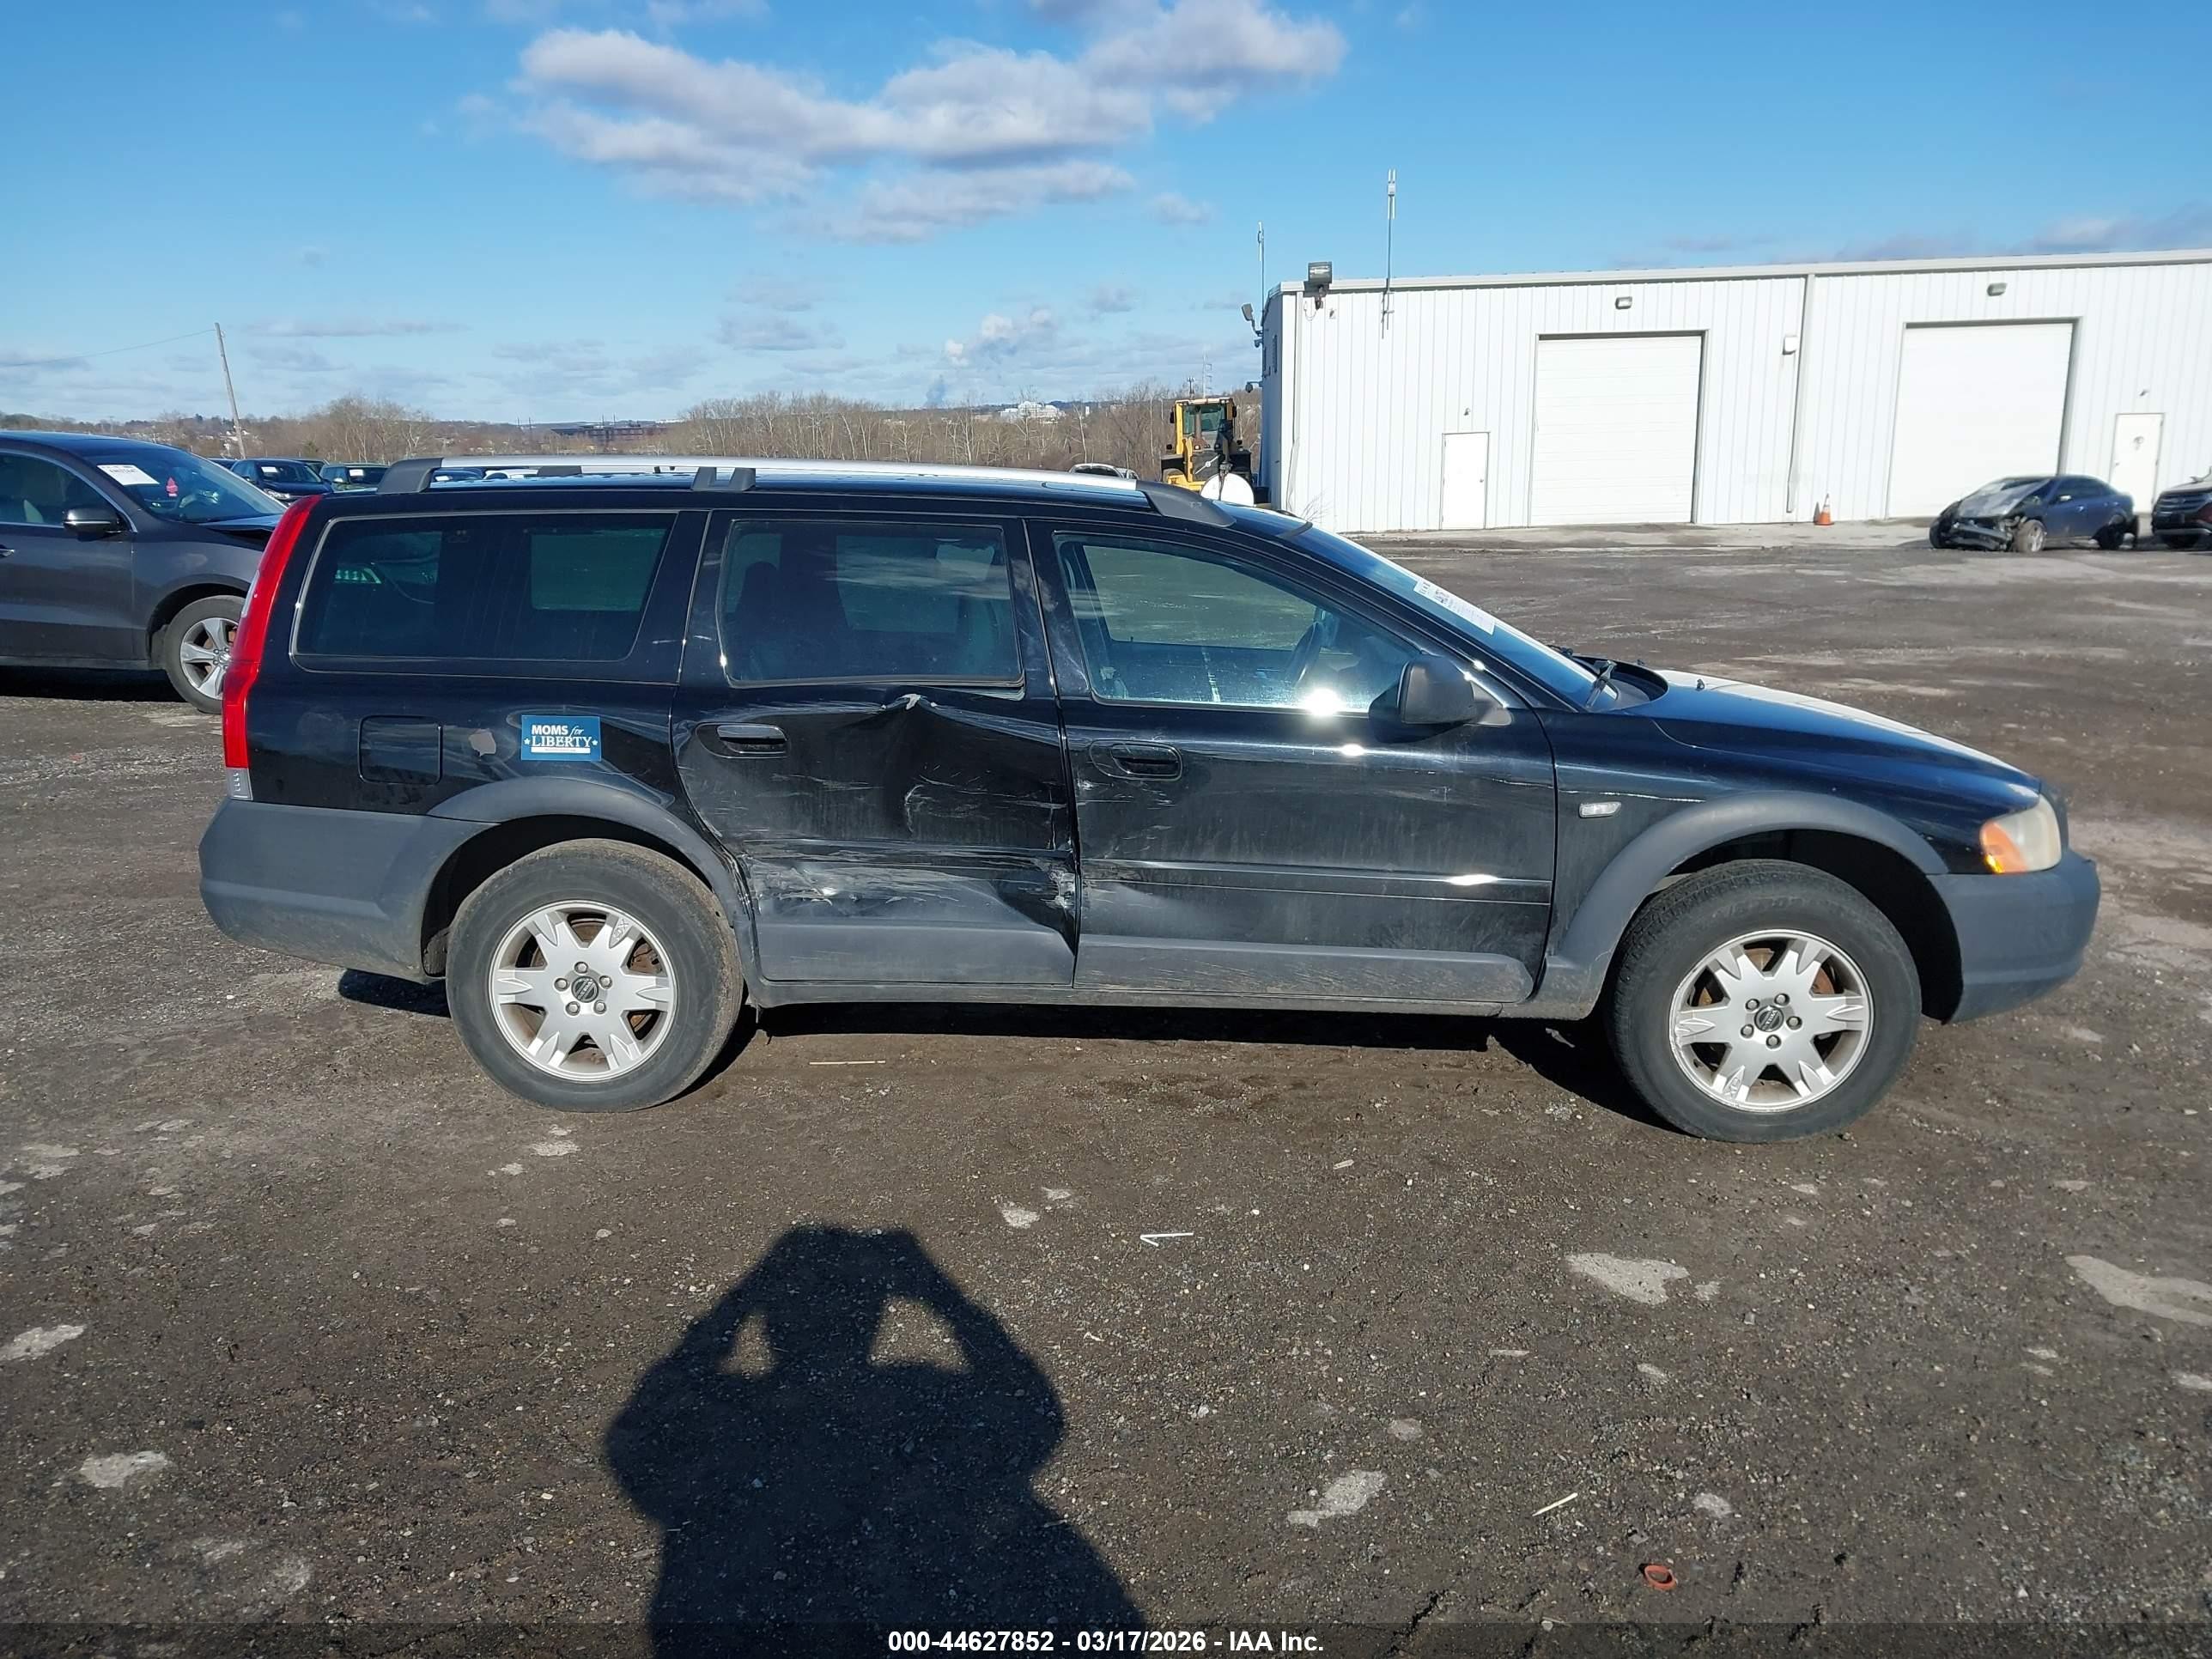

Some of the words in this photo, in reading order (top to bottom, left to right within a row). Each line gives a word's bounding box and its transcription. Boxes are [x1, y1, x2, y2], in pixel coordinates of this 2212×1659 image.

[531, 724, 568, 736] MOMS
[568, 725, 585, 738] for
[532, 735, 592, 748] LIBERTY
